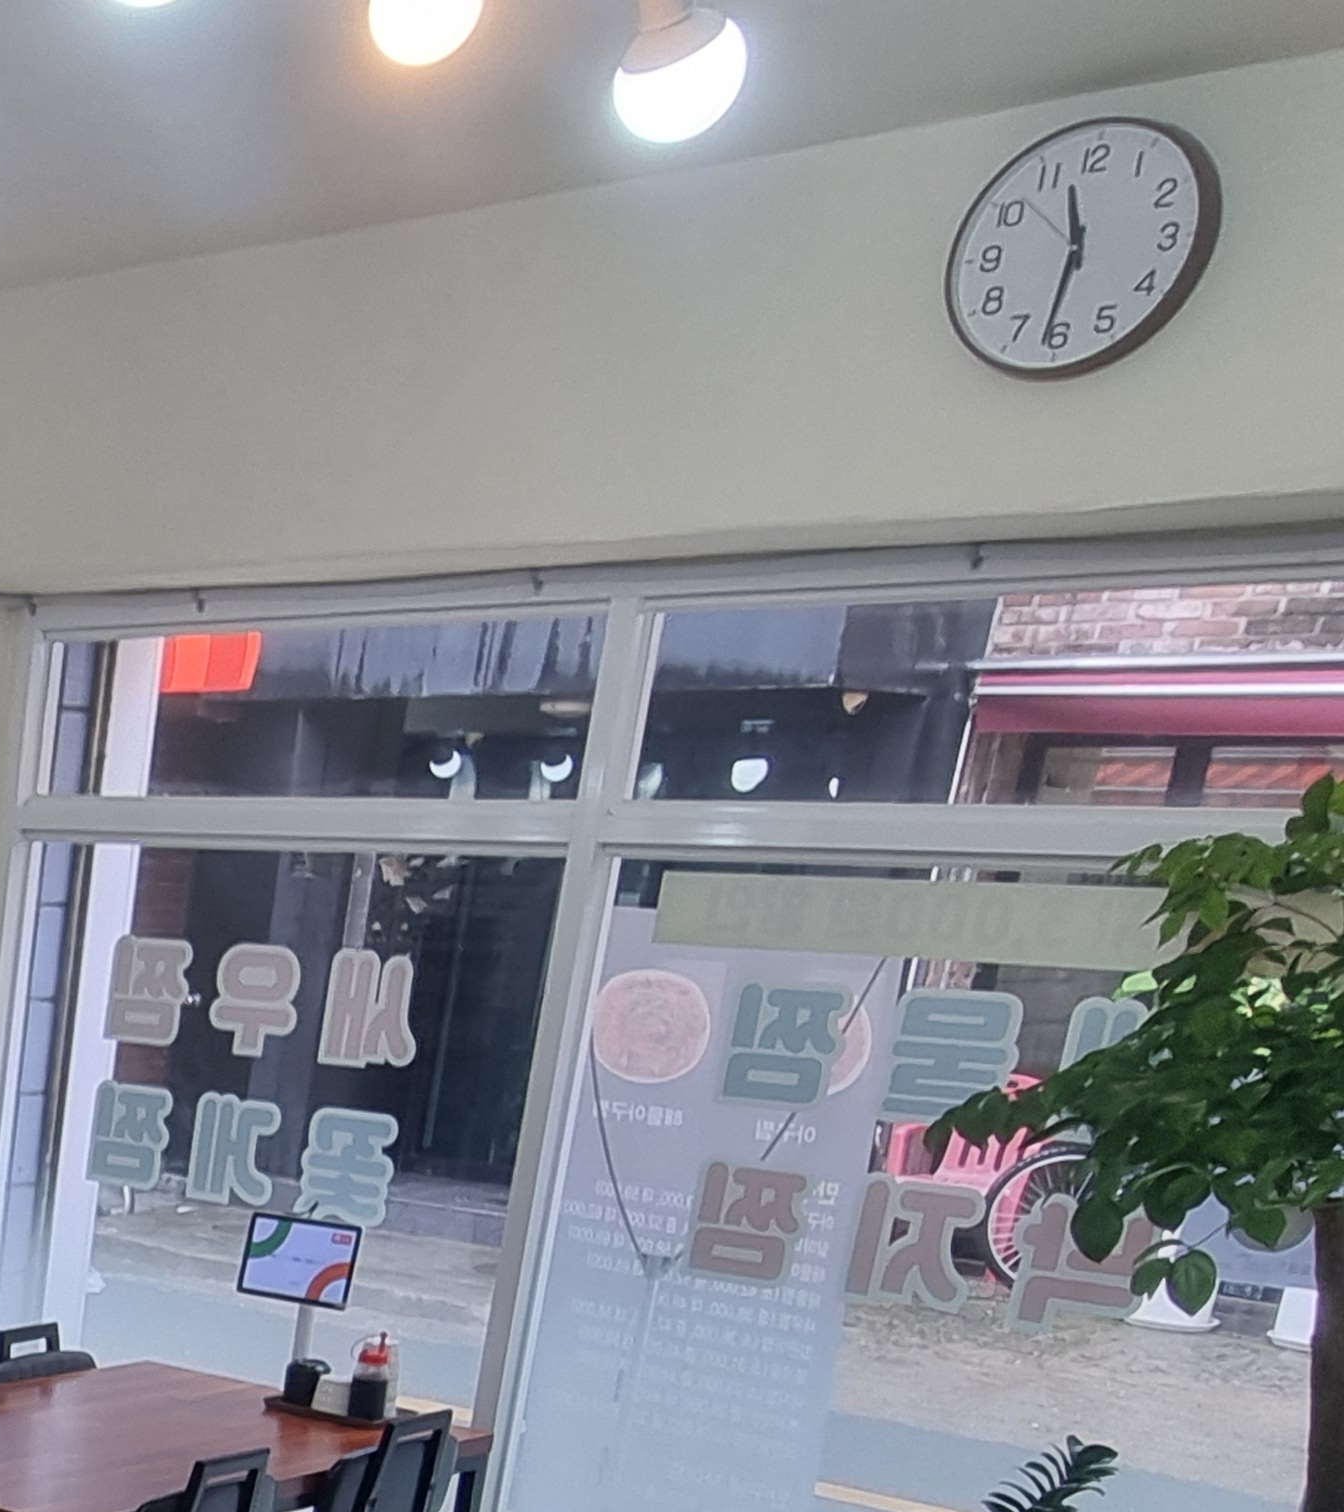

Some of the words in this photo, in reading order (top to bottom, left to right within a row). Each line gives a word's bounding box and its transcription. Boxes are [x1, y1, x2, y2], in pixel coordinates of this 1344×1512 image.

[1081, 143, 1111, 174] 12
[1133, 150, 1145, 178] 1
[1037, 161, 1062, 192] 11
[1154, 177, 1178, 209] 2
[997, 200, 1024, 228] 10
[1156, 221, 1179, 252] 3
[979, 244, 1002, 273] 9
[1133, 269, 1157, 297] 4
[981, 285, 1004, 316] 8
[1009, 314, 1030, 343] 7
[1093, 304, 1118, 334] 5
[1048, 322, 1071, 350] 6
